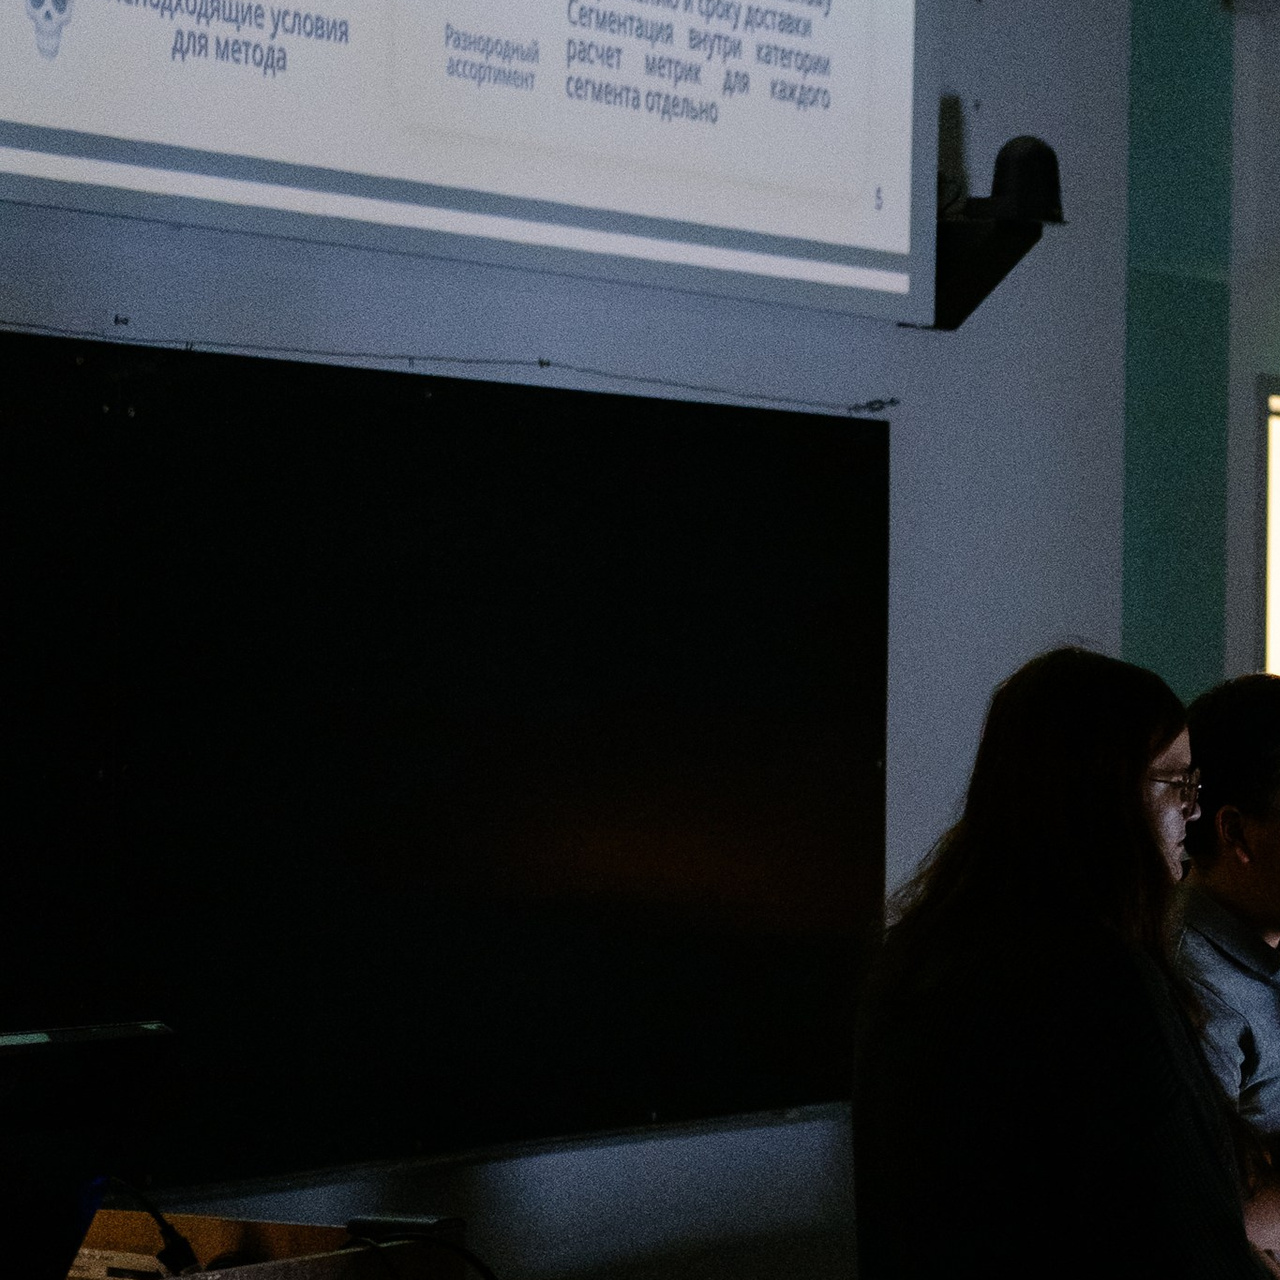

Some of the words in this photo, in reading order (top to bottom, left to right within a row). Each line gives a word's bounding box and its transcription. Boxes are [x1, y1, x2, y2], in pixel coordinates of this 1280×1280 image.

[270, 6, 349, 44] условия
[444, 22, 539, 64] Разнородный
[171, 28, 209, 62] для
[215, 39, 287, 78] метода
[566, 37, 622, 70] расчет
[645, 52, 701, 87] метрик
[723, 69, 749, 98] для
[688, 24, 743, 63] внутри
[756, 39, 830, 78] категории
[446, 55, 536, 91] ассортимент
[566, 73, 641, 112] сегмента
